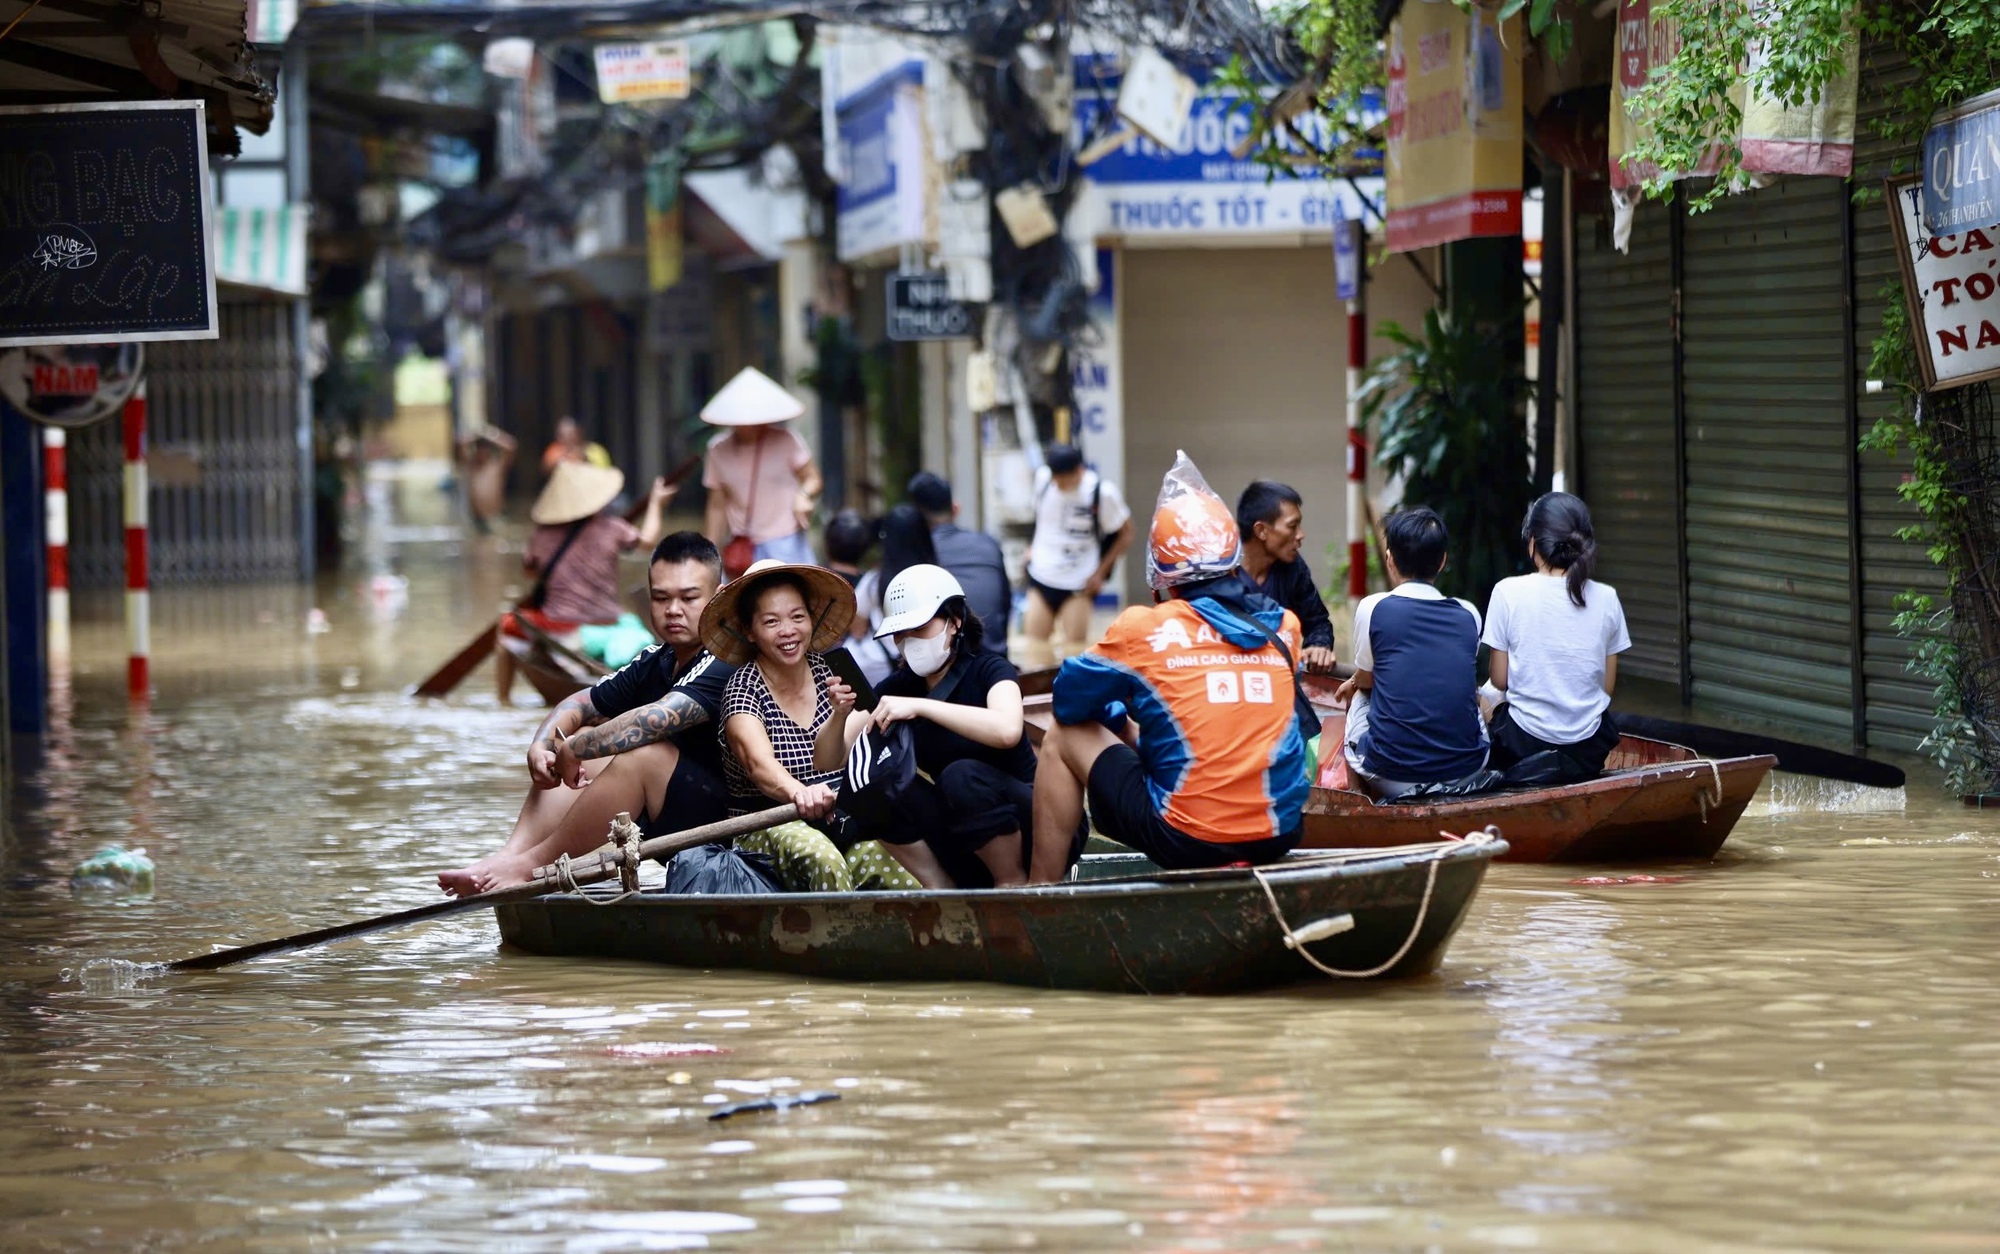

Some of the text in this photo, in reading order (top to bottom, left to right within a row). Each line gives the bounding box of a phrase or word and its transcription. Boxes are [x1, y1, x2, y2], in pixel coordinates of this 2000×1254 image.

[73, 146, 180, 237] BẠC
[1110, 193, 1205, 228] THUỐC
[1217, 192, 1266, 227] TỐT
[1932, 258, 2000, 307] TÓ
[1201, 655, 1228, 666] CAO
[1230, 654, 1260, 665] GIAO
